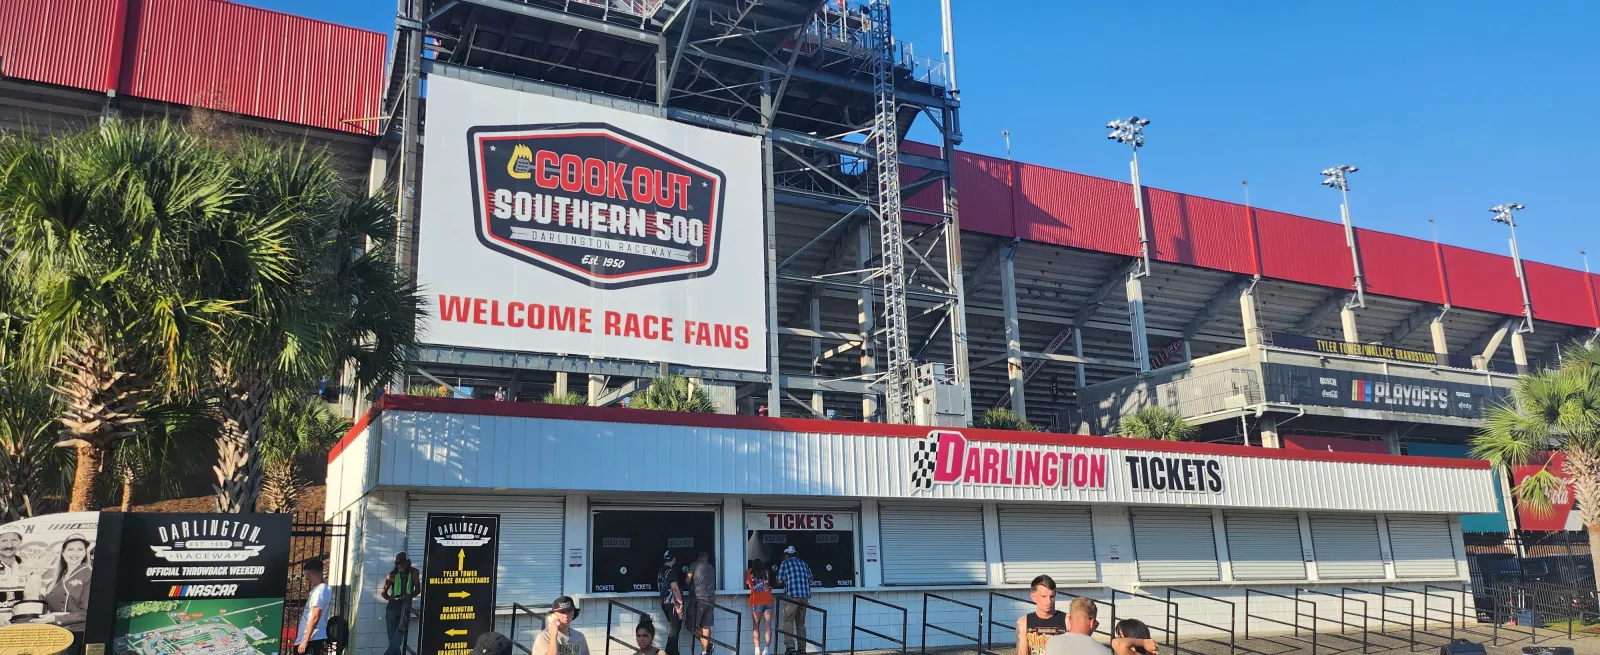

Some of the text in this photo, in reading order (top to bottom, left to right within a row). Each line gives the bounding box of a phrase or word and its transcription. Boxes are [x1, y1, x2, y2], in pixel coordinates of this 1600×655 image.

[534, 150, 692, 210] COOK OUT
[494, 189, 703, 246] SOUTHERN 500
[532, 232, 672, 258] DARLINGTON RACEWAY
[582, 255, 625, 268] Est. 1950
[438, 294, 749, 350] WELCOME RACE FANS
[1316, 340, 1436, 364] TYLER TOWER/WALLACE GRANDSTANDS
[1374, 382, 1448, 409] PLAYOFFS
[933, 432, 1222, 493] DARLINGTON TICKETS
[158, 520, 261, 542] DARLINGTON
[438, 522, 489, 536] DARLINGTON
[767, 514, 834, 529] TICKETS
[175, 552, 241, 560] RACEWAY
[146, 566, 265, 576] OFFICIAL THROWBACK WEEKEND
[185, 584, 238, 597] NASCAR
